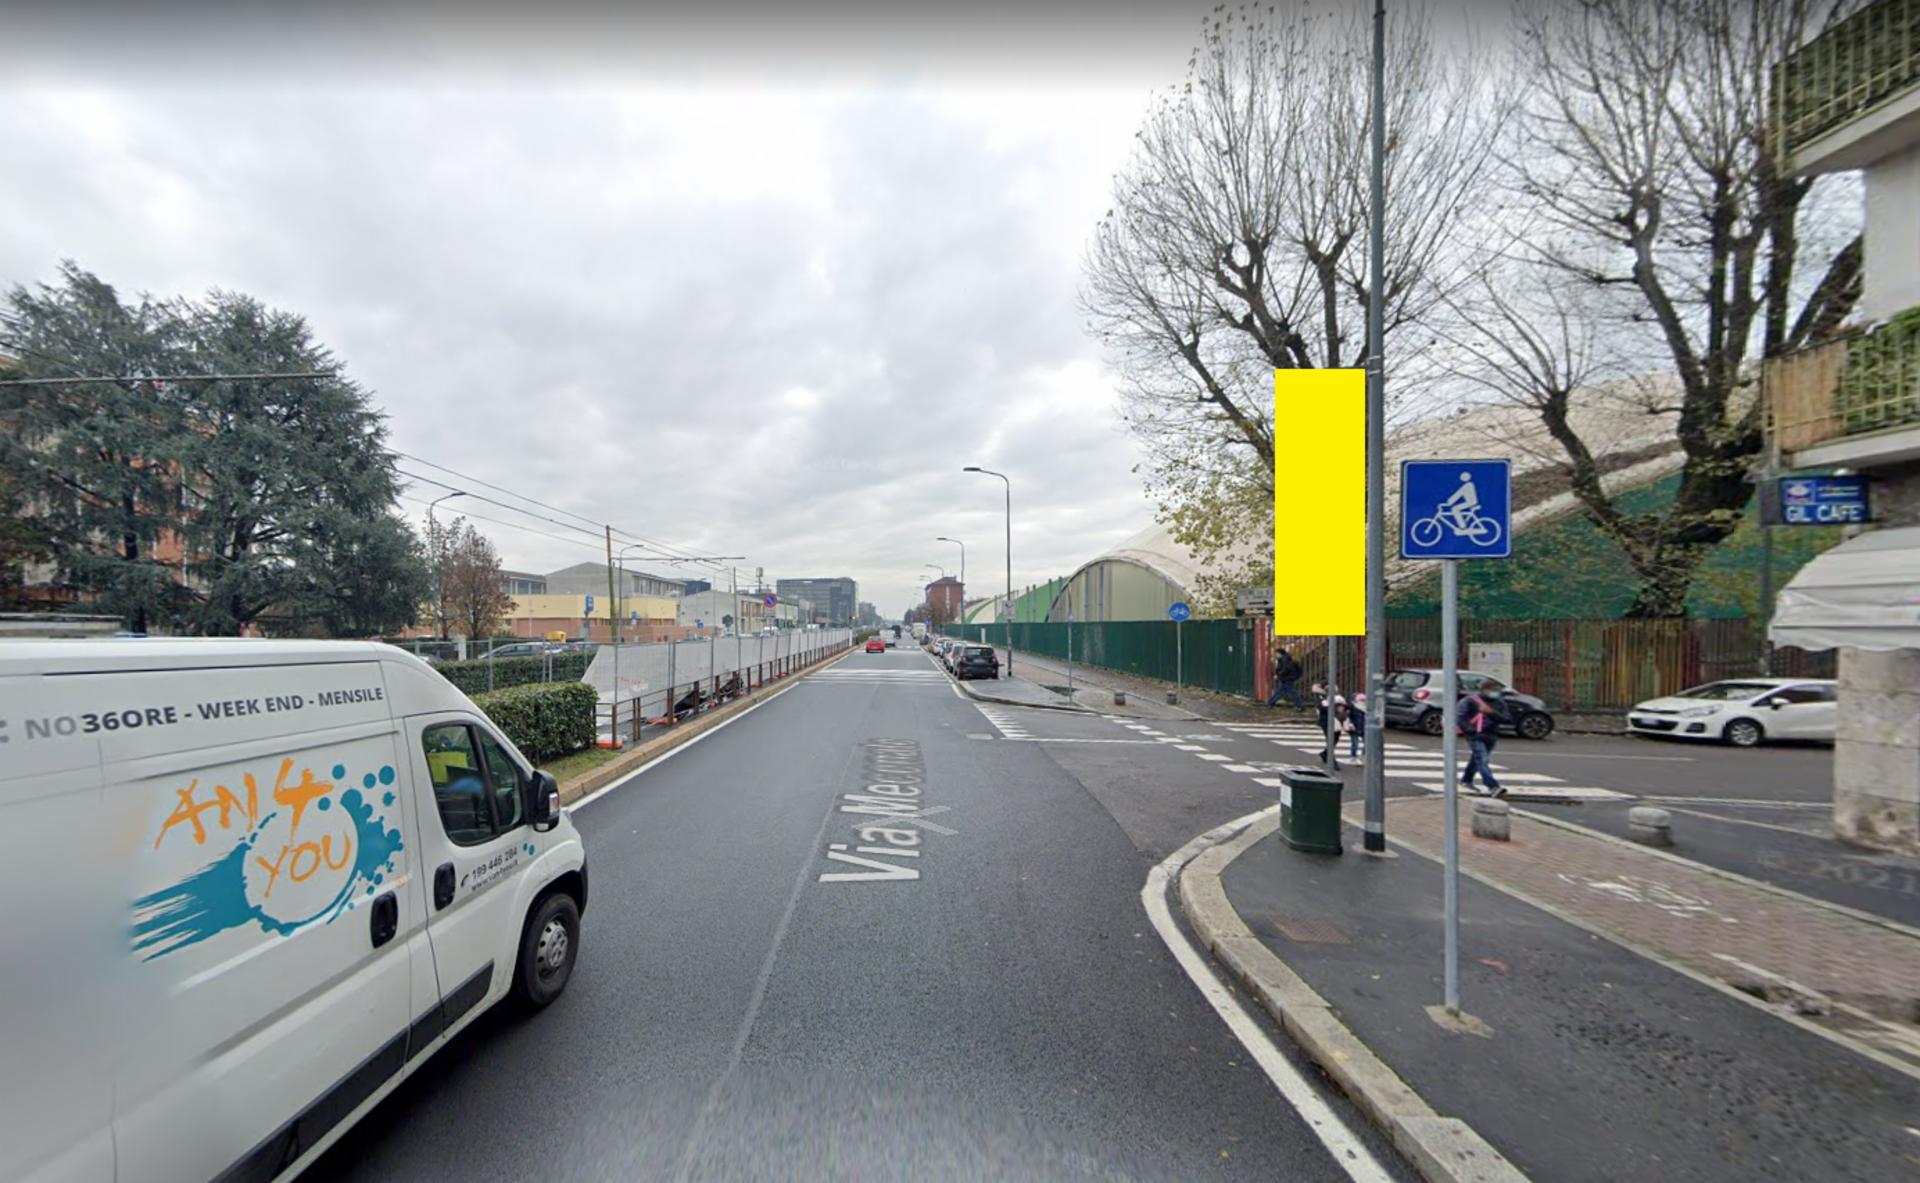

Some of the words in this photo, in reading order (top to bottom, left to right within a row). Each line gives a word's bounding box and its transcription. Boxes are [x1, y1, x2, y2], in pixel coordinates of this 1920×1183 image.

[198, 699, 260, 719] WEEK
[265, 695, 303, 712] END
[318, 687, 383, 706] MENSILE
[255, 830, 352, 898] YOU
